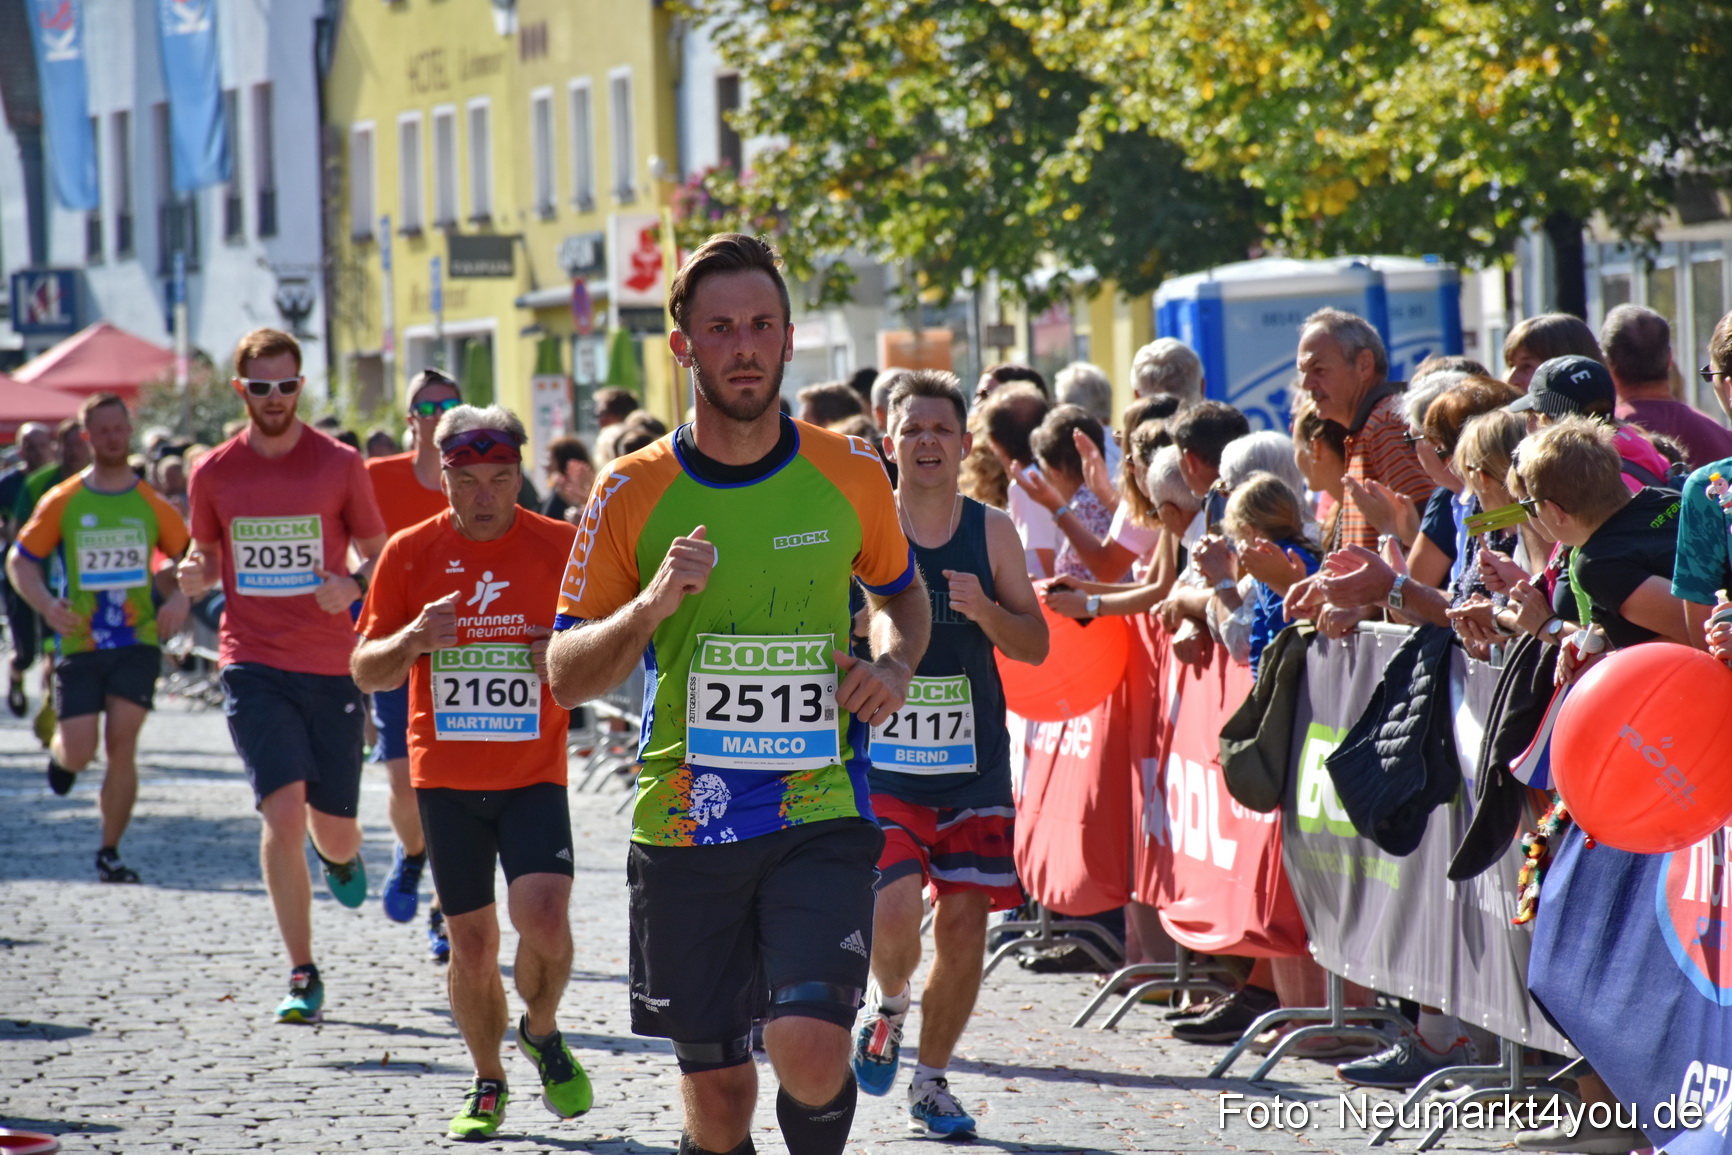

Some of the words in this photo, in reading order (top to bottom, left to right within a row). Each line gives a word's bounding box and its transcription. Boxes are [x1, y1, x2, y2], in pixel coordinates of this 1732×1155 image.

[238, 520, 315, 539] BOCK
[773, 529, 830, 550] BOCK
[86, 549, 140, 569] 2729
[243, 545, 312, 569] 2035
[244, 574, 315, 587] ALEXANDER
[457, 614, 525, 628] nrunners
[466, 623, 535, 639] neumark
[438, 647, 532, 669] BOCK
[700, 640, 829, 671] BOCK
[443, 677, 529, 708] 2160
[907, 679, 966, 701] OCK
[706, 682, 823, 723] 2513
[446, 716, 525, 730] HARTMUT
[883, 711, 963, 740] 2117
[722, 736, 806, 754] MARCO
[895, 748, 949, 764] BERND
[840, 941, 868, 960] adidas
